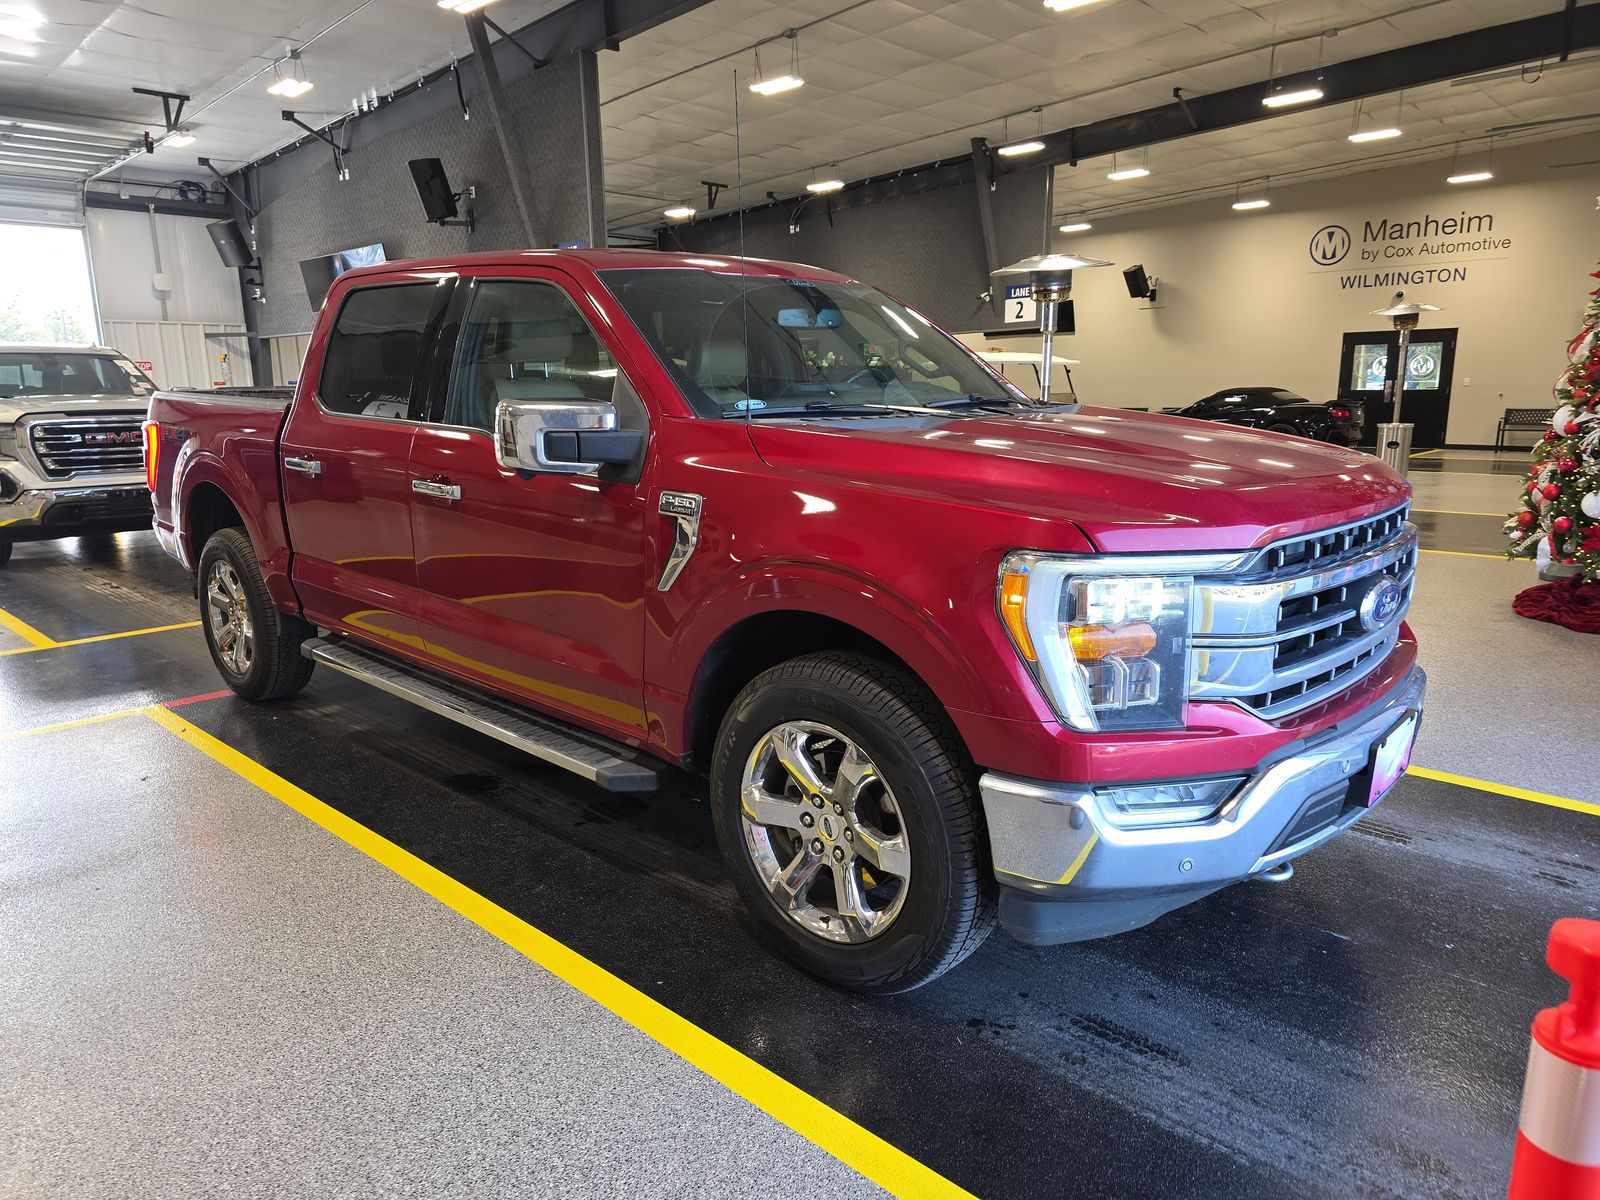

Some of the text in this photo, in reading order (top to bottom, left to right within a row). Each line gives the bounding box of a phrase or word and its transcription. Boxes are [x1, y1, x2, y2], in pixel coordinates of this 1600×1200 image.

[1362, 211, 1494, 243] Manheim
[1361, 236, 1512, 263] by Cox Automotive
[1340, 267, 1467, 289] WILMINGTON
[1011, 286, 1030, 298] LANE
[1015, 301, 1024, 319] 2
[85, 431, 143, 444] GMC
